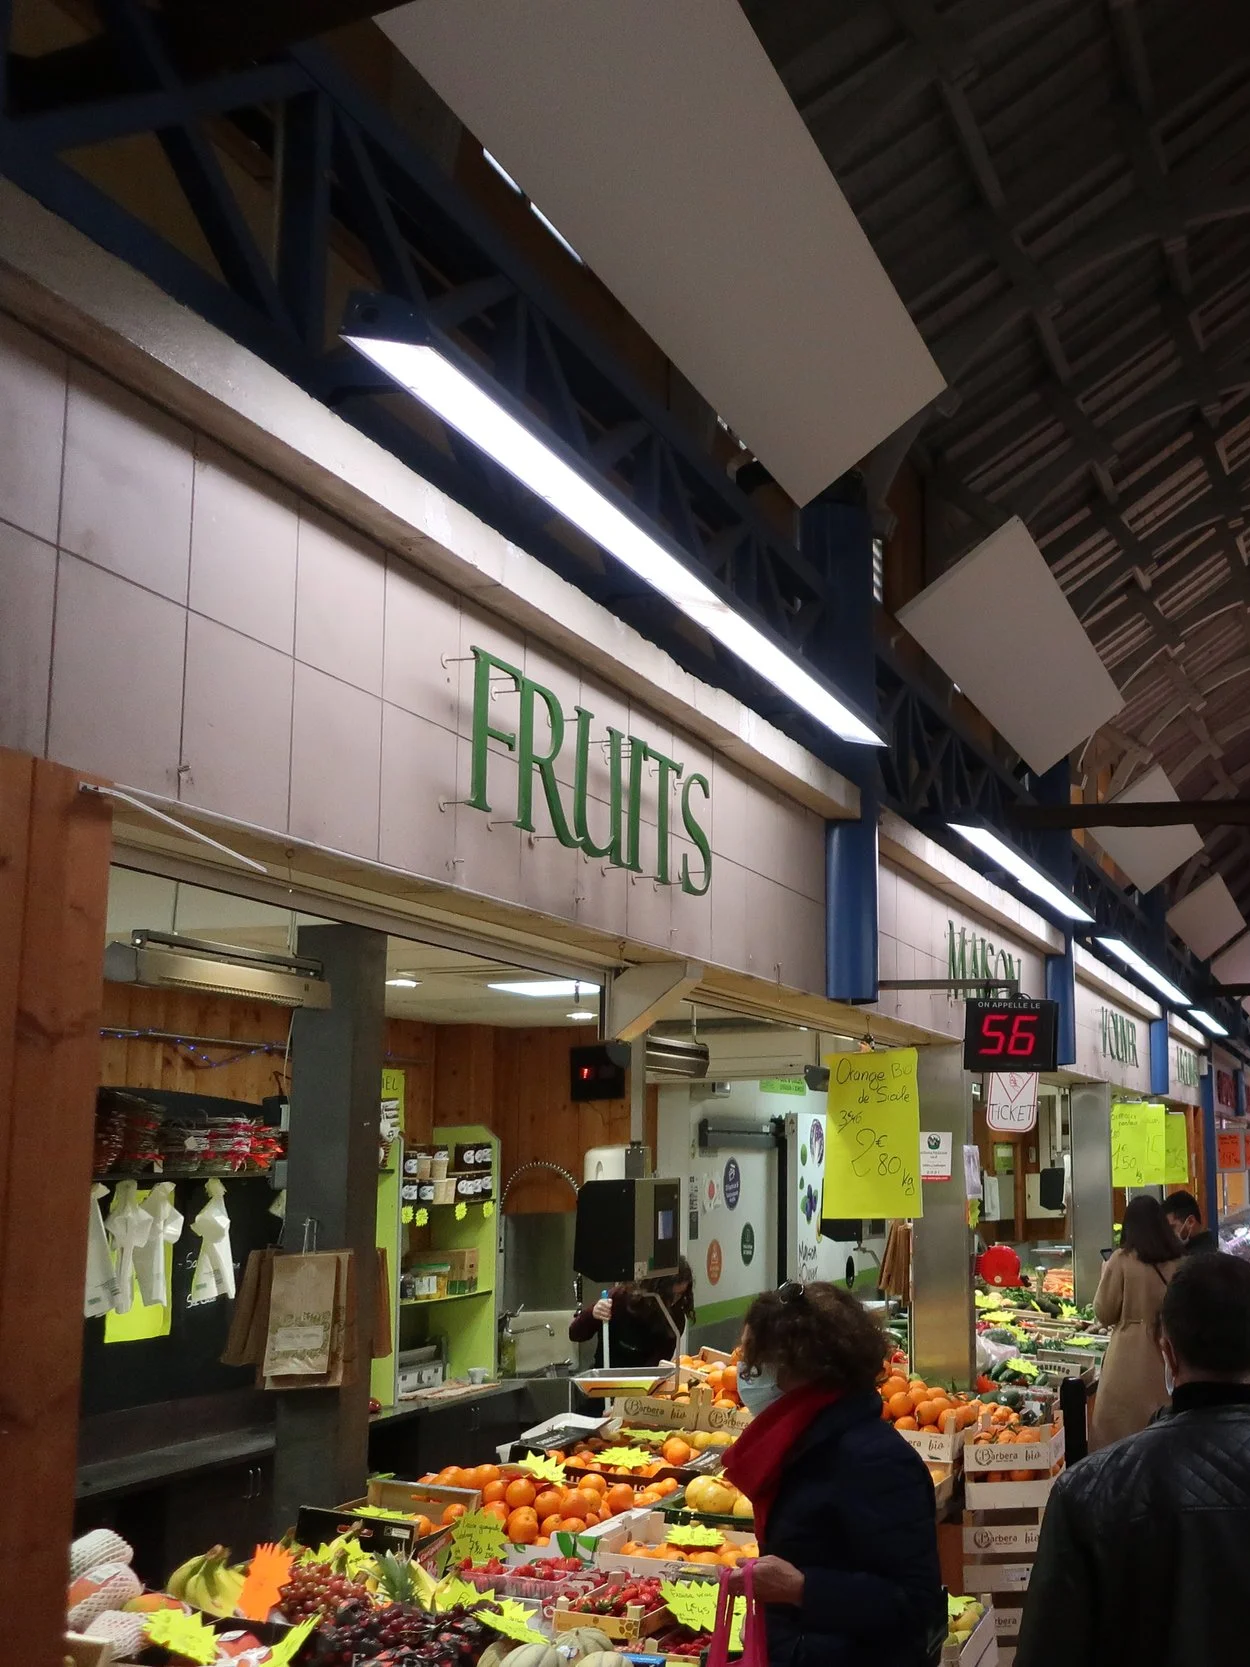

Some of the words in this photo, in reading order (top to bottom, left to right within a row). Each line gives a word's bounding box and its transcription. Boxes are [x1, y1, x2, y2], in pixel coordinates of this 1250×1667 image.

[469, 645, 714, 897] FRUITS
[979, 1015, 1039, 1056] 56
[836, 1057, 885, 1091] Orange
[858, 1089, 869, 1103] de
[902, 1168, 916, 1196] kg
[625, 1398, 665, 1418] Barbera
[670, 1406, 687, 1420] bio
[928, 1438, 945, 1451] bio
[975, 1447, 1018, 1467] Barbera
[1024, 1448, 1041, 1462] bio
[974, 1529, 1018, 1549] Barbera
[994, 1616, 1018, 1626] rbera
